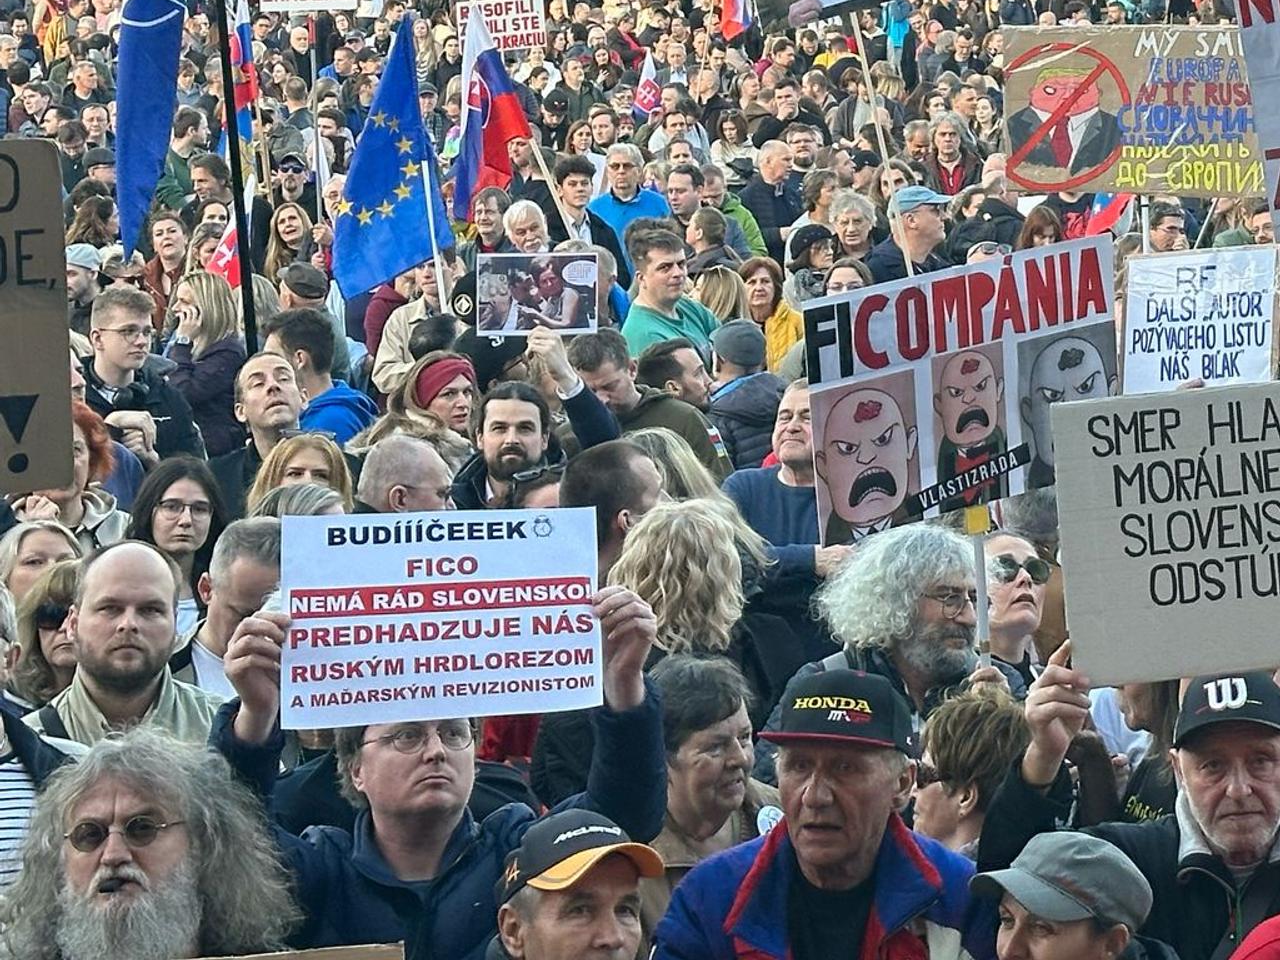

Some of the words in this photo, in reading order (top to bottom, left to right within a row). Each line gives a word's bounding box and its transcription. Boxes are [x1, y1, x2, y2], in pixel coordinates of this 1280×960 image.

[512, 16, 540, 31] STE
[1134, 31, 1180, 57] MY
[1150, 57, 1241, 84] EUROPA
[1135, 82, 1196, 106] NIE
[1115, 161, 1147, 188] ДО
[803, 247, 1108, 385] FICOMPÁNIA
[1160, 352, 1190, 382] NÁŠ
[1087, 408, 1181, 457] SMER
[918, 453, 1018, 509] VLASTIZRADA
[327, 519, 527, 546] BUDÍÍÍČEEEK
[407, 556, 478, 578] FICO
[291, 591, 365, 613] NEMÁ
[373, 589, 424, 610] RÁD
[432, 584, 592, 607] SLOVENSKO!
[290, 617, 521, 650] PREDHADZUJE
[532, 610, 593, 636] NÁS
[291, 656, 404, 683] RUSKÝM
[414, 648, 593, 674] HRDLOREZOM
[291, 695, 304, 708] A
[311, 683, 435, 707] MAĎARSKÝM
[443, 675, 594, 697] REVIZIONISTOM
[793, 696, 872, 713] HONDA
